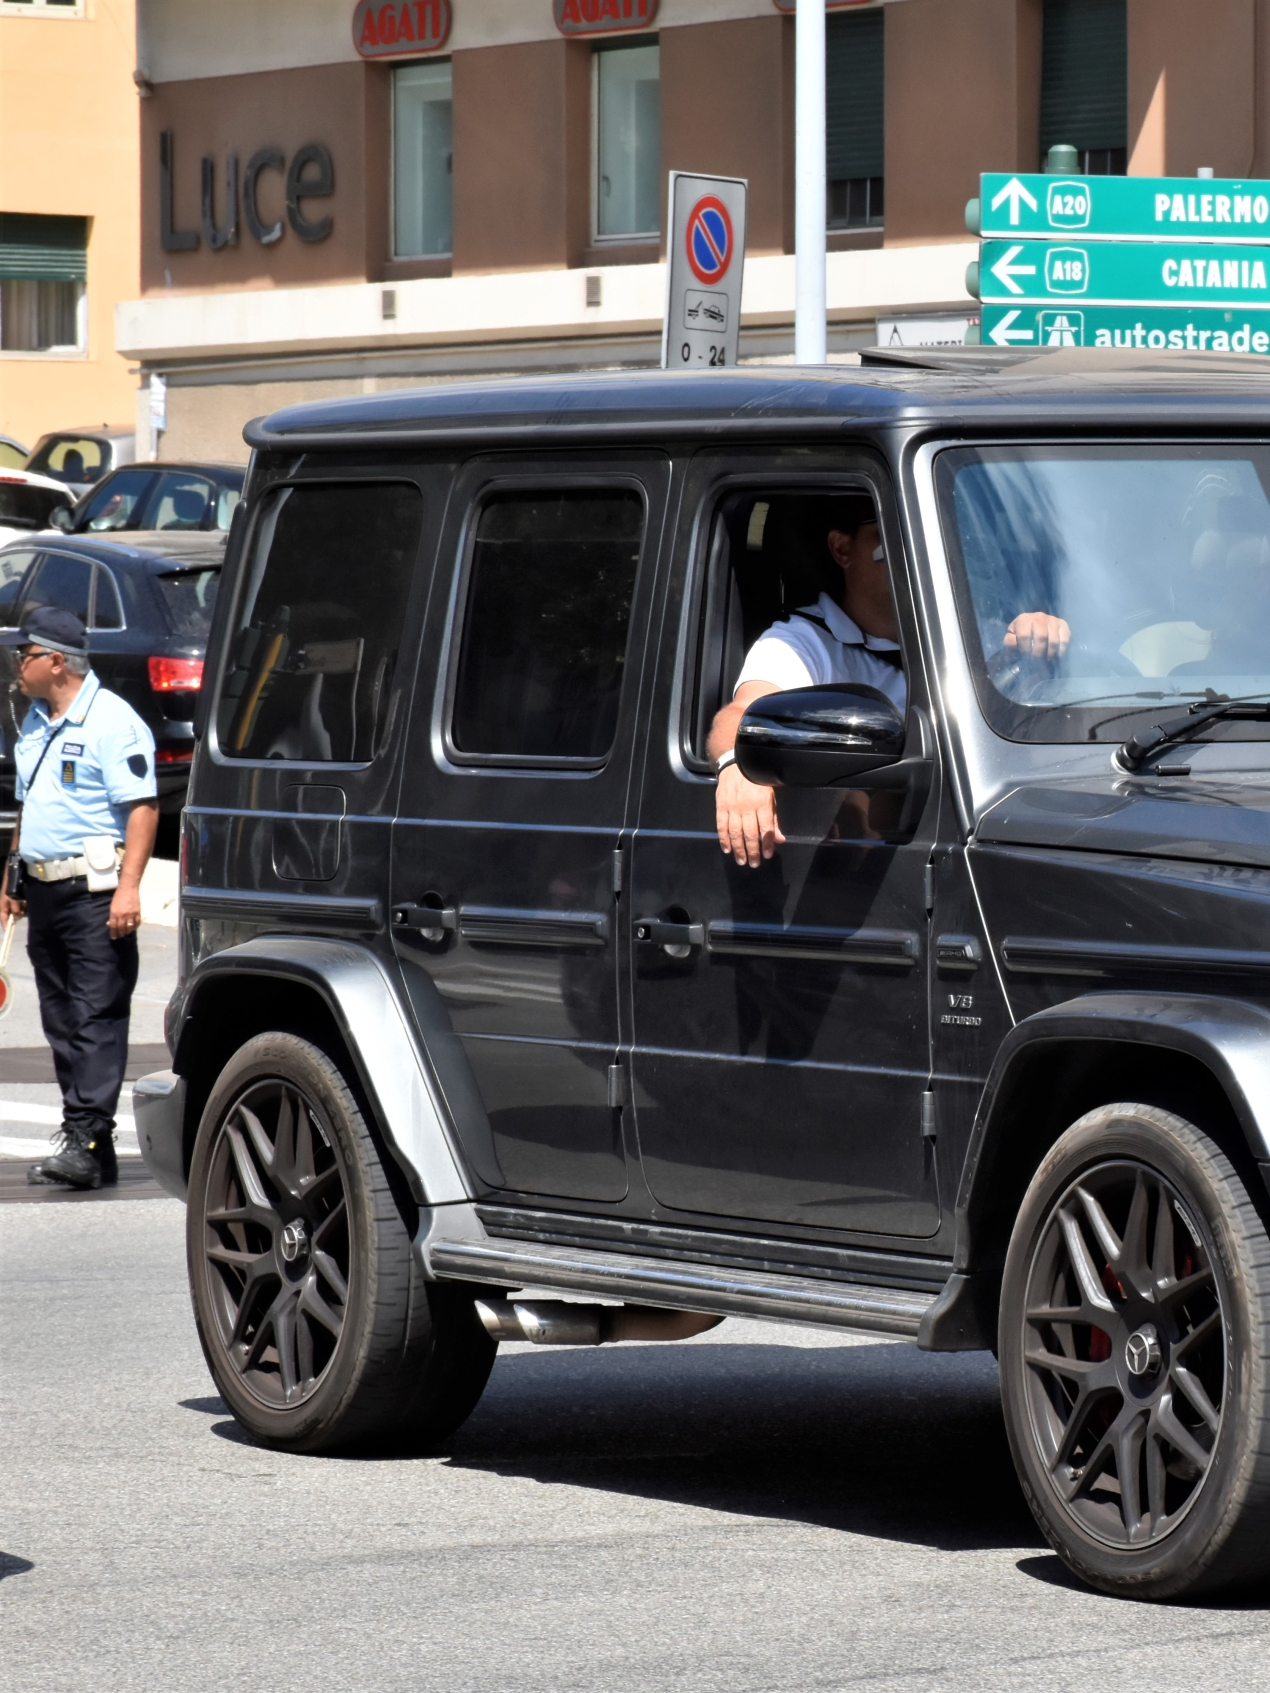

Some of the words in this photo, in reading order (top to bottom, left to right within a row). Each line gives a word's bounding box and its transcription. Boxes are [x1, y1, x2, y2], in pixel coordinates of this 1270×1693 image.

[359, 0, 441, 48] AGATI
[159, 131, 334, 252] Luce
[1052, 196, 1087, 216] A20
[1155, 193, 1269, 224] PALERMO
[1052, 262, 1083, 282] A18
[1162, 258, 1267, 289] CATANIA
[1095, 322, 1269, 353] autostrade
[948, 995, 972, 1008] V8
[941, 1015, 981, 1026] BITURBO
